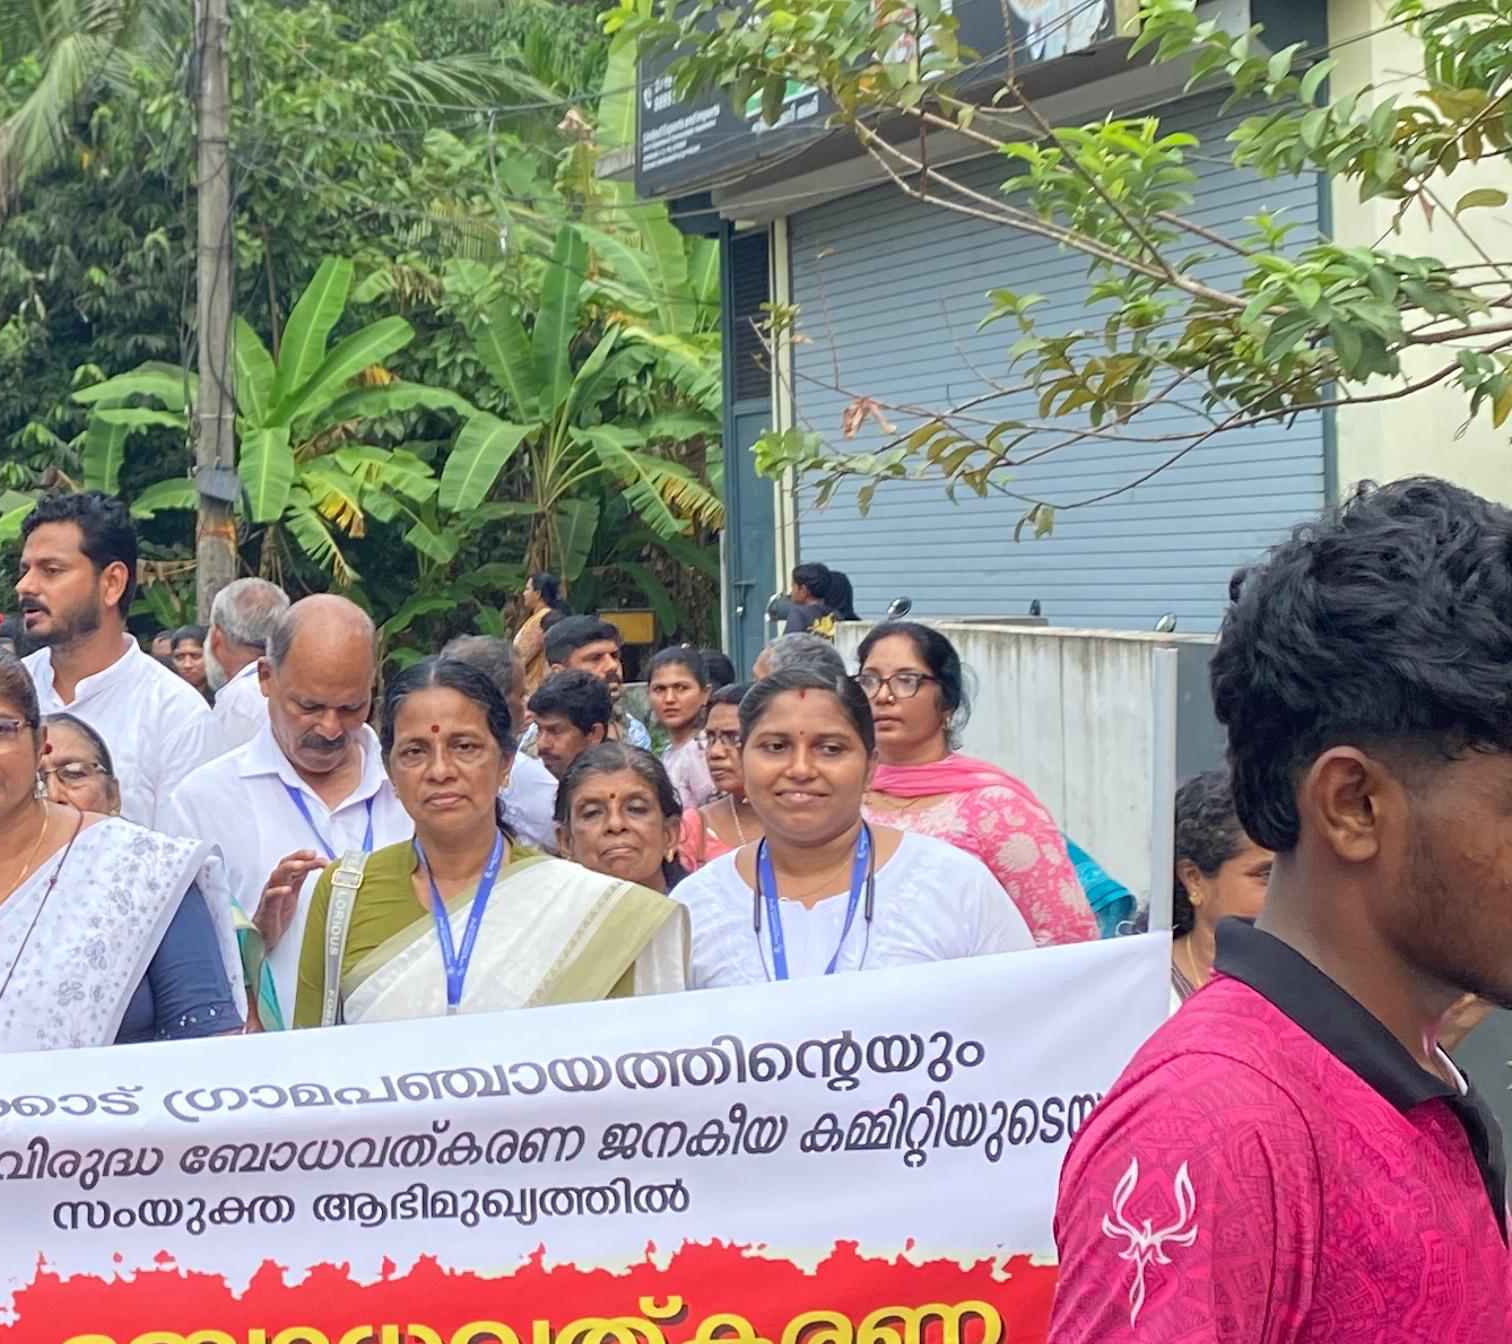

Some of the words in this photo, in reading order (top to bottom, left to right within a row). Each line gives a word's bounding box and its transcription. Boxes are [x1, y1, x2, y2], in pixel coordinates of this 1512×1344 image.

[330, 890, 348, 956] LORIOUS
[163, 1030, 985, 1123] ഗ്രാമപഞ്ചായത്തിന്റെയും
[180, 1120, 585, 1175] ബോധവത്കരണ
[598, 1102, 788, 1160] ജനകീയ
[53, 1193, 295, 1235] സംയുക്ത
[313, 1177, 688, 1227] ആഭിമുഖ്യത്തിൽ
